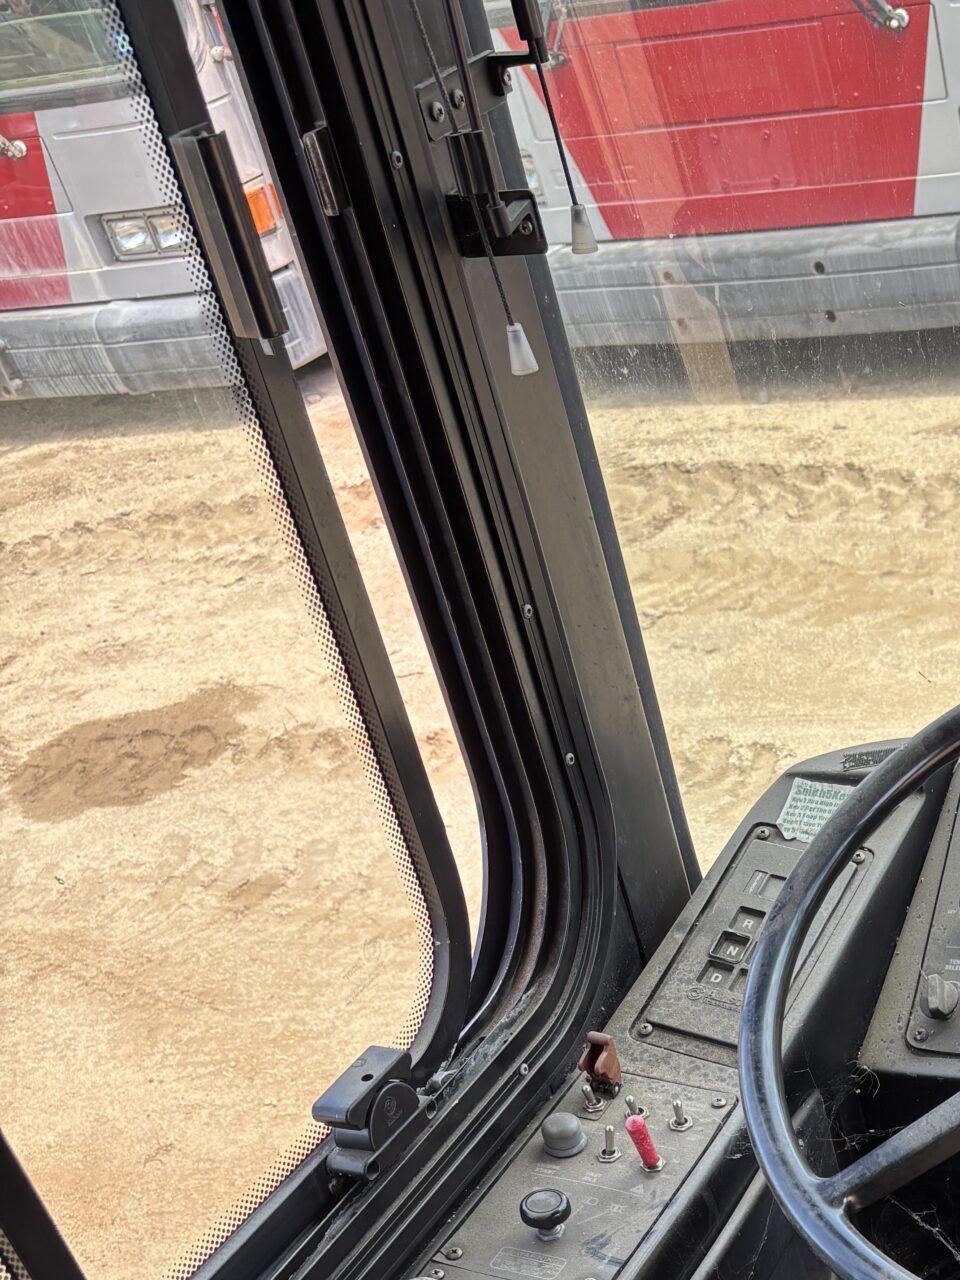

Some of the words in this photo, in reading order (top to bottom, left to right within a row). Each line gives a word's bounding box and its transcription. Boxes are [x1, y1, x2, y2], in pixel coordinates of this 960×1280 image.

[742, 919, 754, 929] R
[726, 946, 739, 956] N
[710, 973, 722, 983] D
